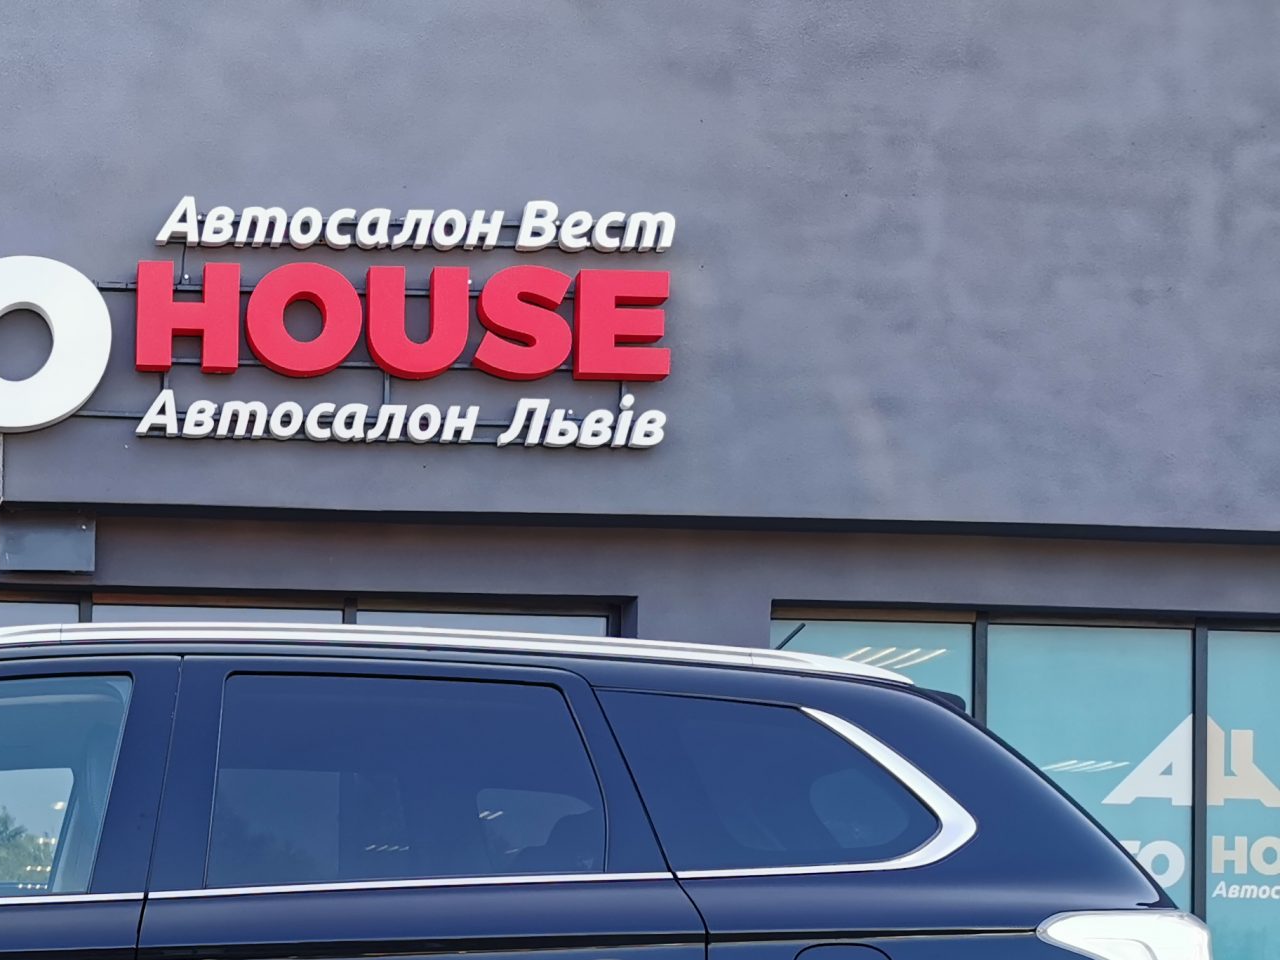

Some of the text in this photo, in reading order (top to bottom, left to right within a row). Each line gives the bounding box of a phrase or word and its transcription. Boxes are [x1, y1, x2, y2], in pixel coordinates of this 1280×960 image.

[155, 196, 676, 253] Автосалон Вест
[136, 260, 670, 382] HOUSE
[136, 389, 667, 449] Автосалон Львів
